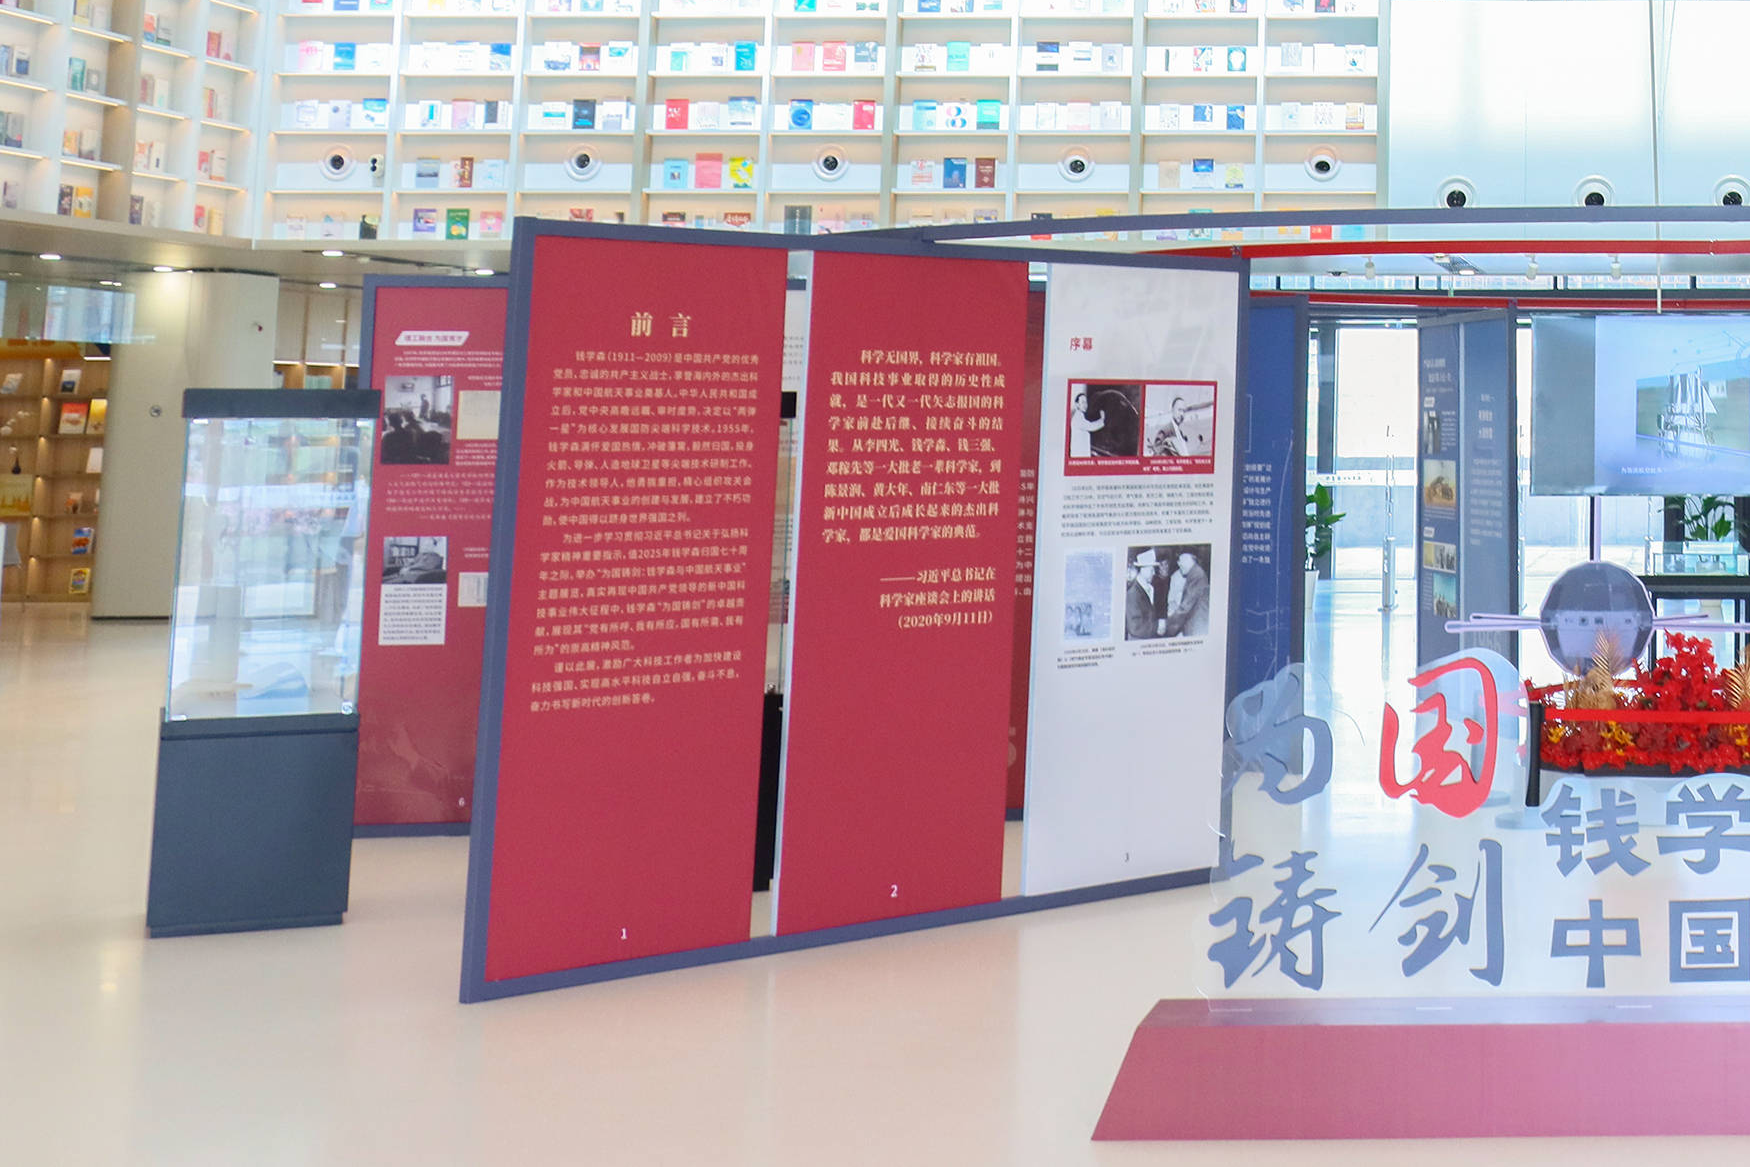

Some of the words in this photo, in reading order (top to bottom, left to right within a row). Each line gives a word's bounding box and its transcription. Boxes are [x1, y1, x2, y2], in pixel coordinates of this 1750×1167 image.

[631, 312, 691, 337] 前言
[1070, 337, 1093, 351] 序幕
[861, 350, 1001, 366] 科学无国界，科学家有祖国。
[830, 372, 1006, 388] 我国科技事业取得的历史性成
[829, 416, 1003, 431] 学家前赴后继、接续奋斗的结
[823, 502, 999, 521] 新中国成立后成长起来的杰出科
[880, 588, 996, 608] 科学家座谈会上的讲话
[1228, 656, 1499, 818] 为国
[890, 885, 899, 898] 2
[1207, 837, 1505, 991] 铸剑
[620, 928, 627, 939] 1
